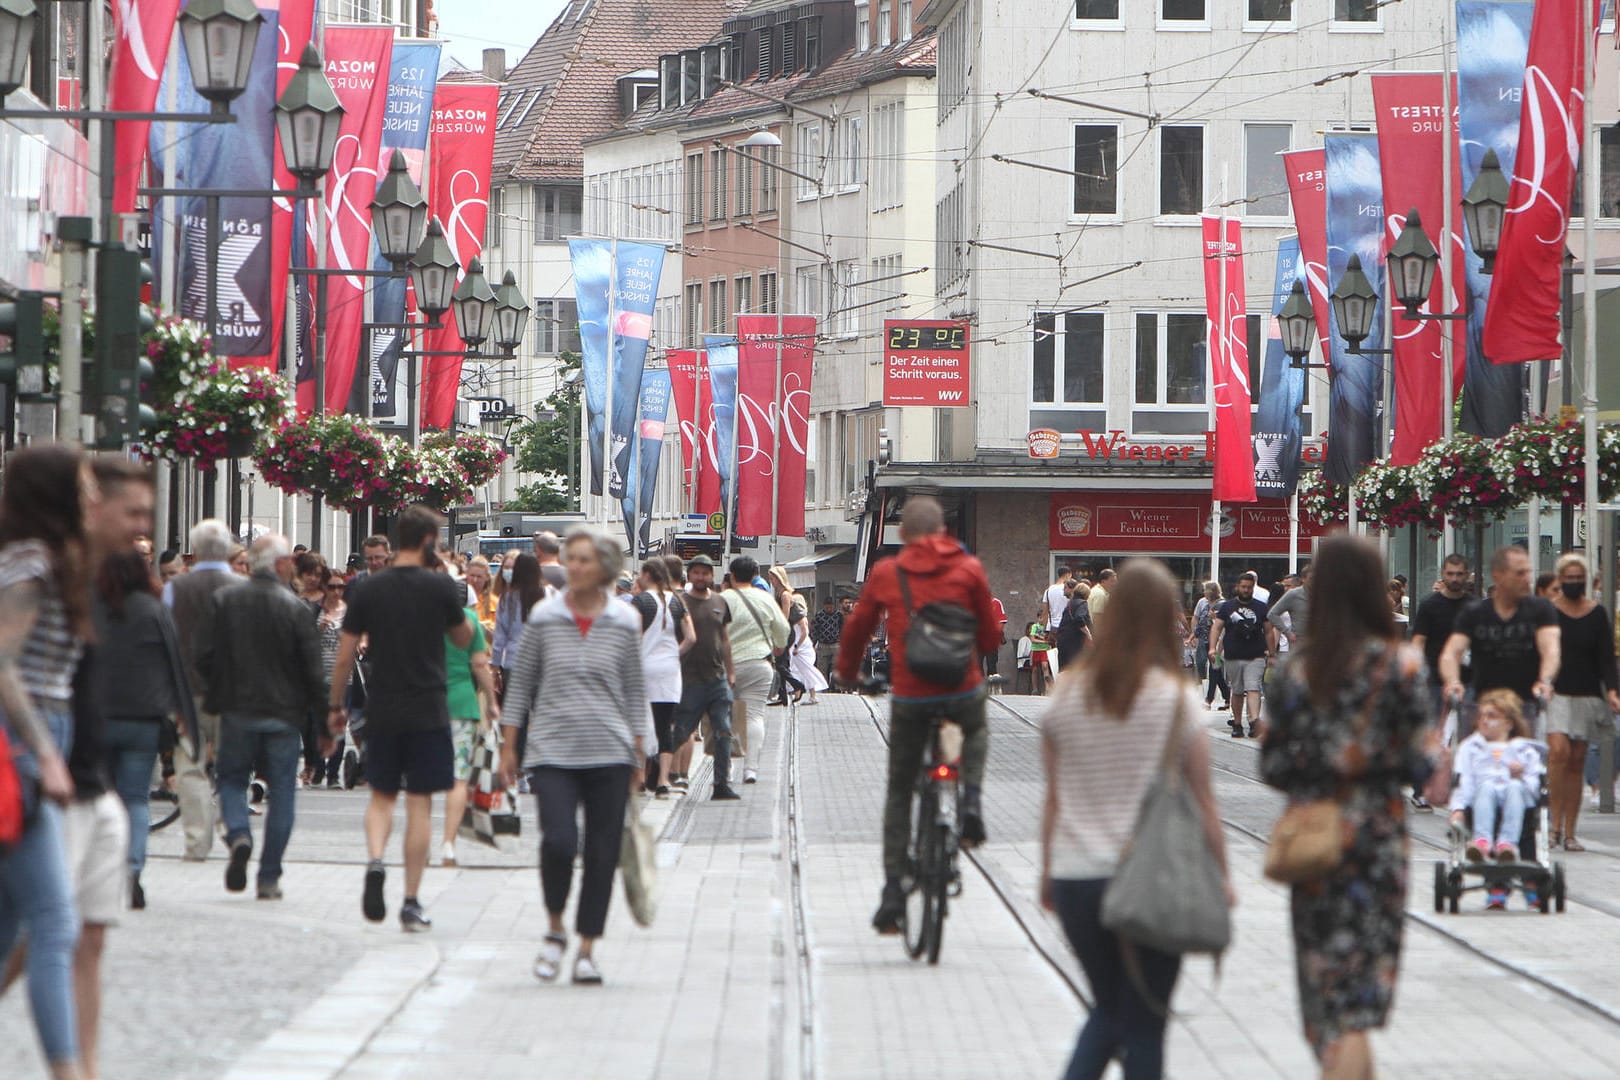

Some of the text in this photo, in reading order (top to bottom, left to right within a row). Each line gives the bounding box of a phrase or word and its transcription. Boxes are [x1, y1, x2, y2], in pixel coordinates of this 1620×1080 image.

[890, 328, 920, 349] 23
[890, 355, 959, 367] Der Zeit einen
[889, 368, 962, 380] Schritt voraus.
[938, 390, 962, 401] WVV
[1075, 429, 1195, 461] Wiener
[1130, 509, 1170, 521] Wiener
[1248, 511, 1287, 523] Warme
[1120, 522, 1180, 534] Feinbäcker
